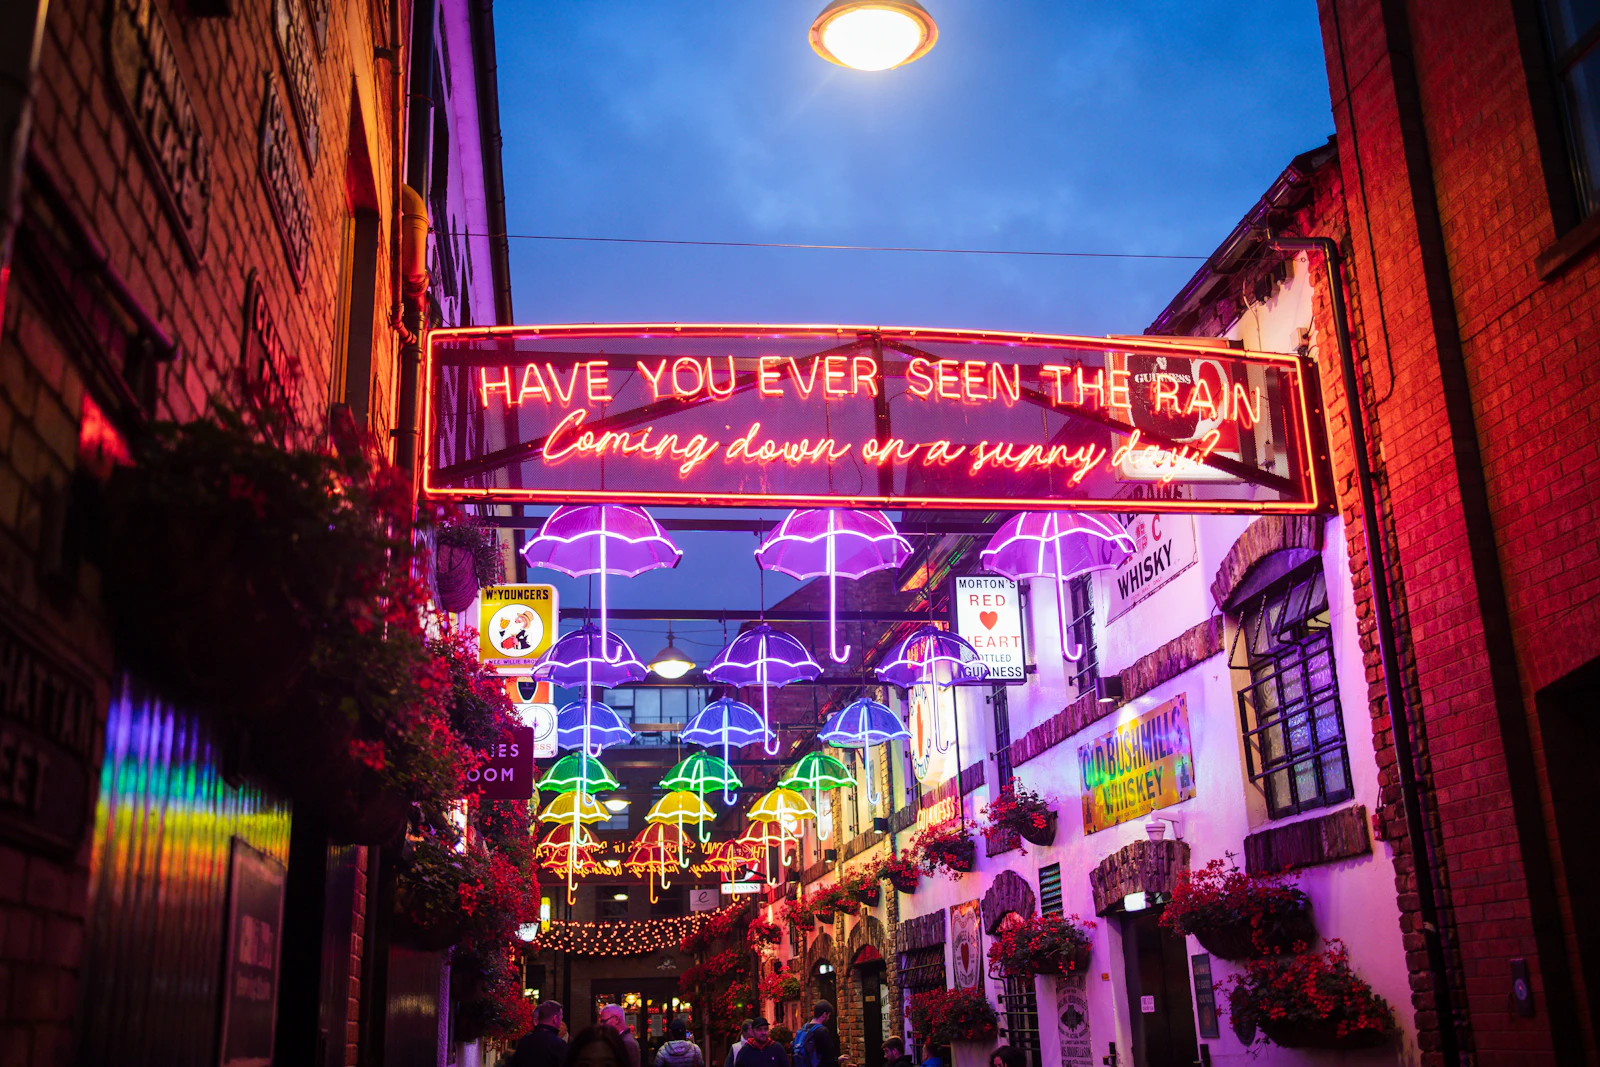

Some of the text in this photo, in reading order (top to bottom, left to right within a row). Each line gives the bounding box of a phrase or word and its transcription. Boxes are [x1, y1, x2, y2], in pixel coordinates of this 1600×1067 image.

[480, 354, 1262, 425] HAVE YOU EVER SEEN THE RAIN
[543, 408, 1221, 483] Coming down on a sunny day?
[959, 579, 1016, 606] MORTON'S RED
[1117, 539, 1172, 600] WHISKY
[964, 666, 1022, 677] GUINESS
[467, 768, 514, 782] OOM
[1103, 766, 1164, 815] WHISKEY
